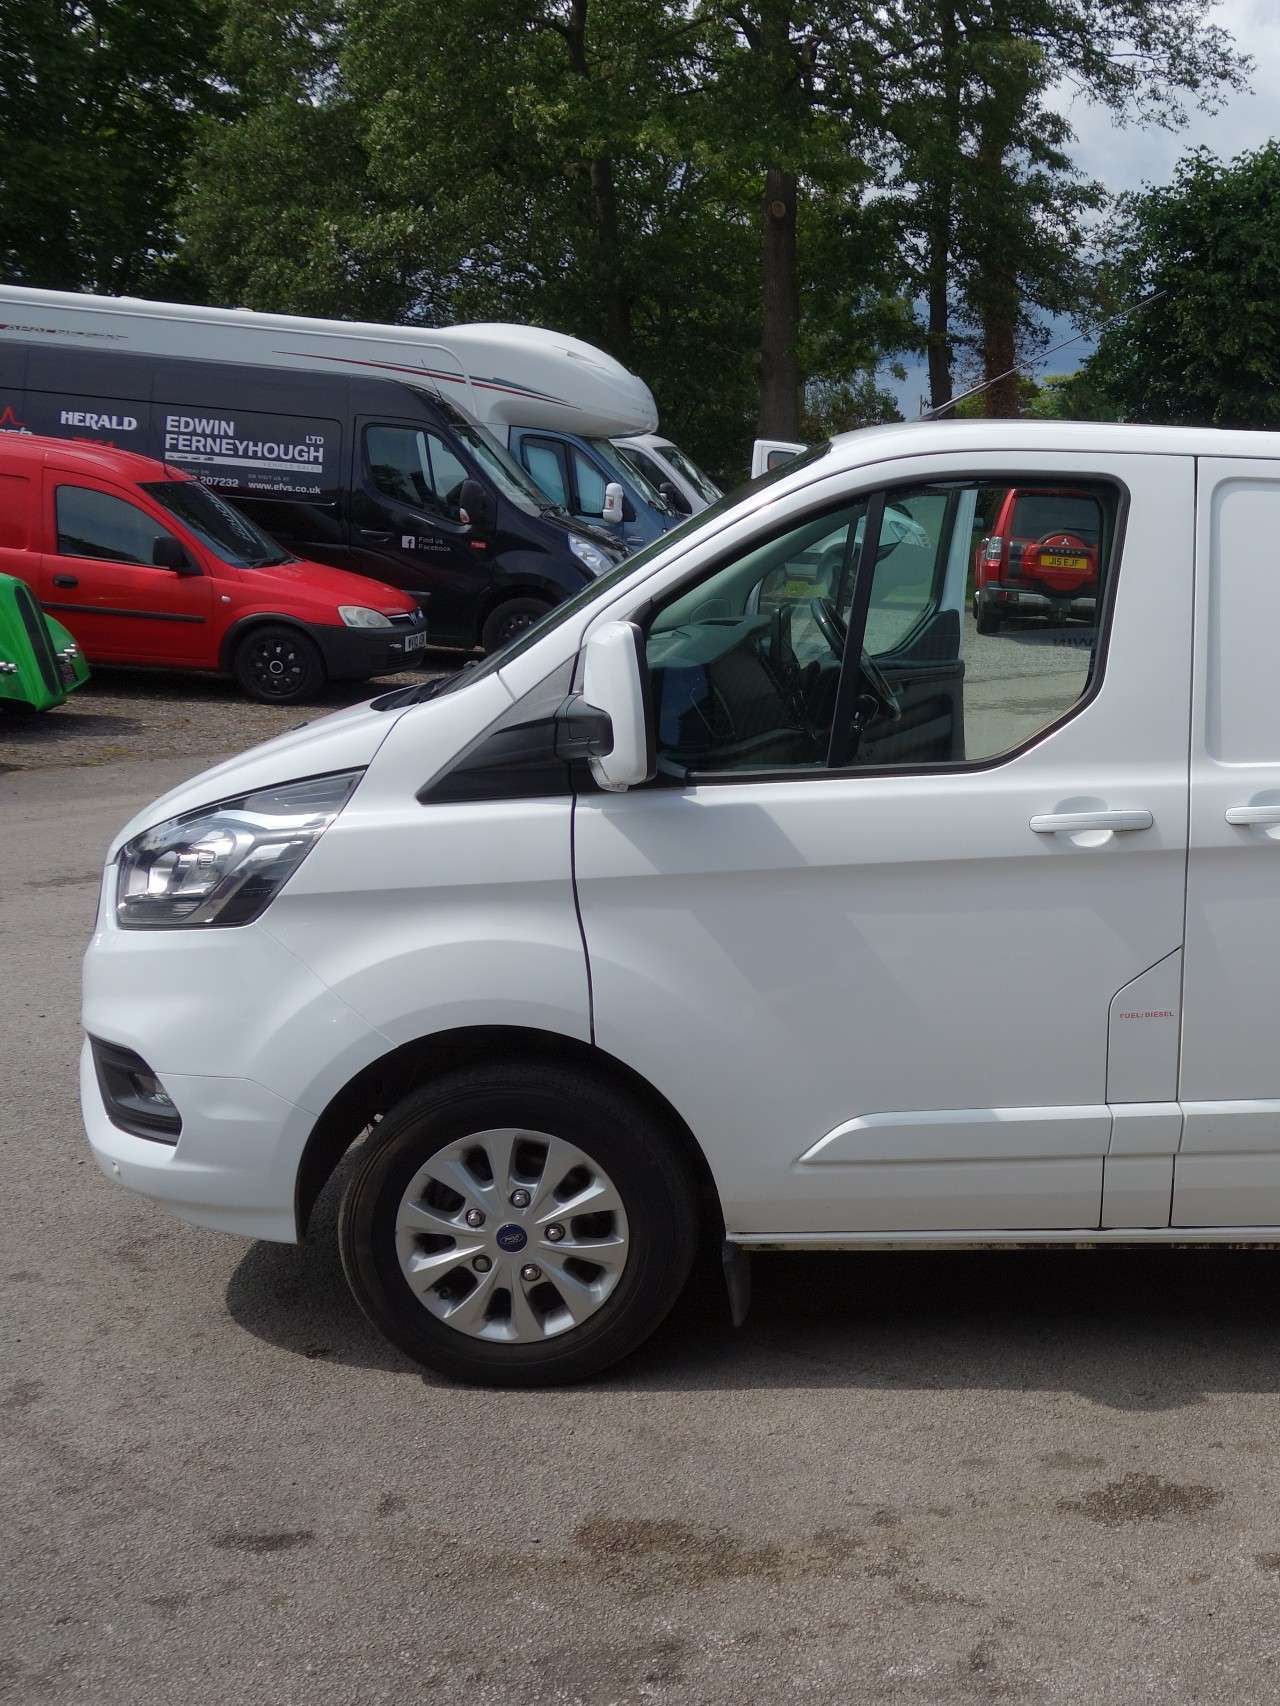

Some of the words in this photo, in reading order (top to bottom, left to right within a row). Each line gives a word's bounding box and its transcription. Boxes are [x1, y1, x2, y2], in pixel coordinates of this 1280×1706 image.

[60, 411, 137, 430] HERALD
[166, 415, 235, 436] EDWIN
[165, 433, 324, 462] FERNEYHOUGH
[305, 435, 324, 445] LTD
[200, 476, 239, 488] 207232
[248, 481, 321, 494] www.efvs.co.uk
